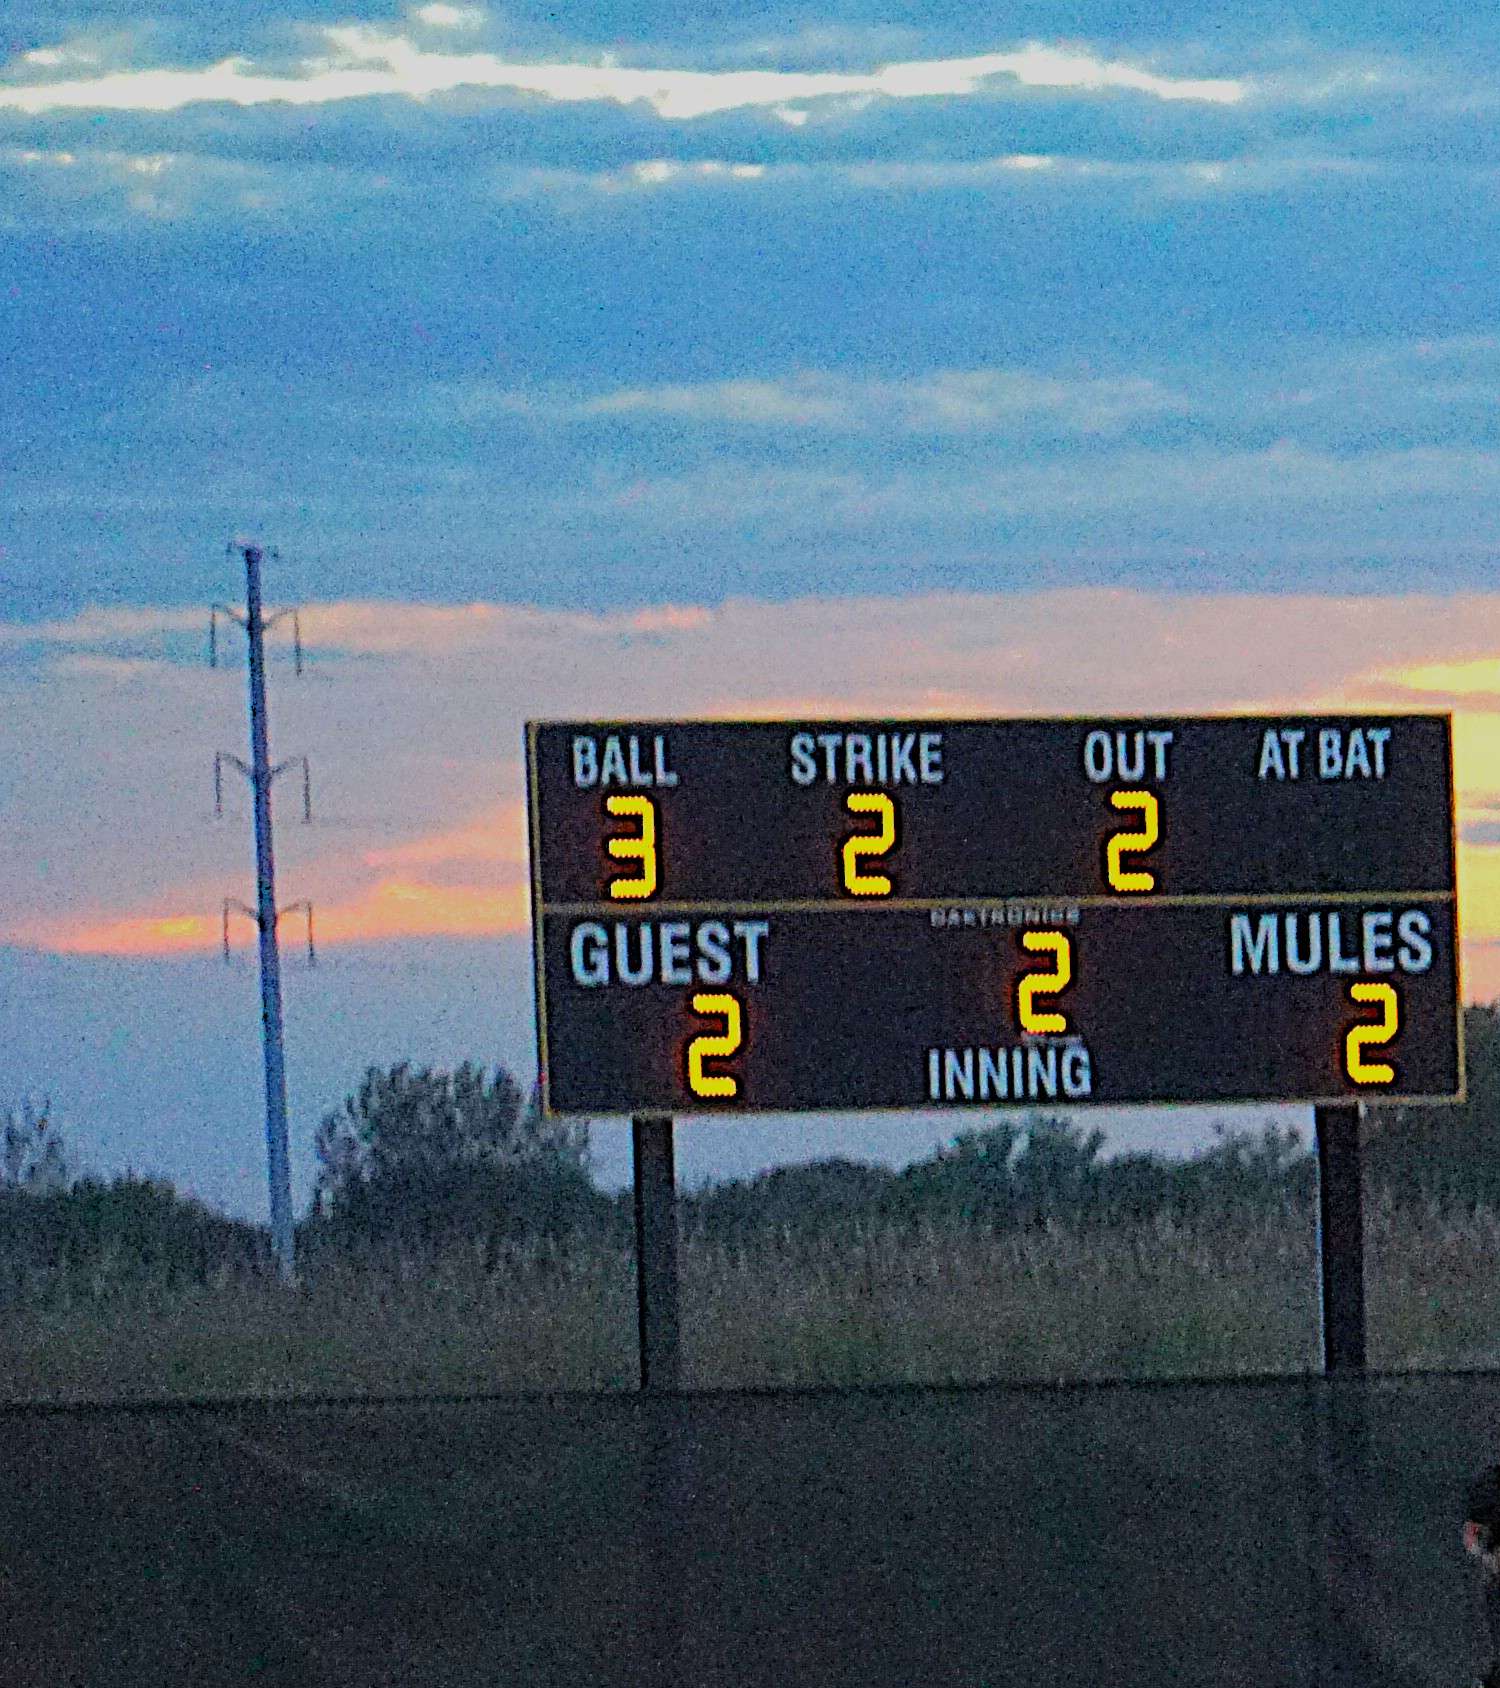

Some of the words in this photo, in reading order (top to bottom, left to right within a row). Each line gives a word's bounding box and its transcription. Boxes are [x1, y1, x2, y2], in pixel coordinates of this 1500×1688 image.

[573, 735, 678, 787] BALL
[791, 732, 943, 785] STRIKE
[1084, 730, 1173, 783] OUT
[1258, 730, 1305, 779] AT
[1318, 728, 1391, 779] BAT
[607, 796, 657, 899] 3
[842, 793, 895, 896] 2
[1106, 790, 1159, 892] 2
[571, 921, 769, 985] GUEST
[1230, 911, 1432, 974] MULES
[1018, 931, 1071, 1033] 2
[688, 994, 741, 1097] 2
[1346, 983, 1398, 1084] 2
[929, 1046, 1092, 1099] INNING
